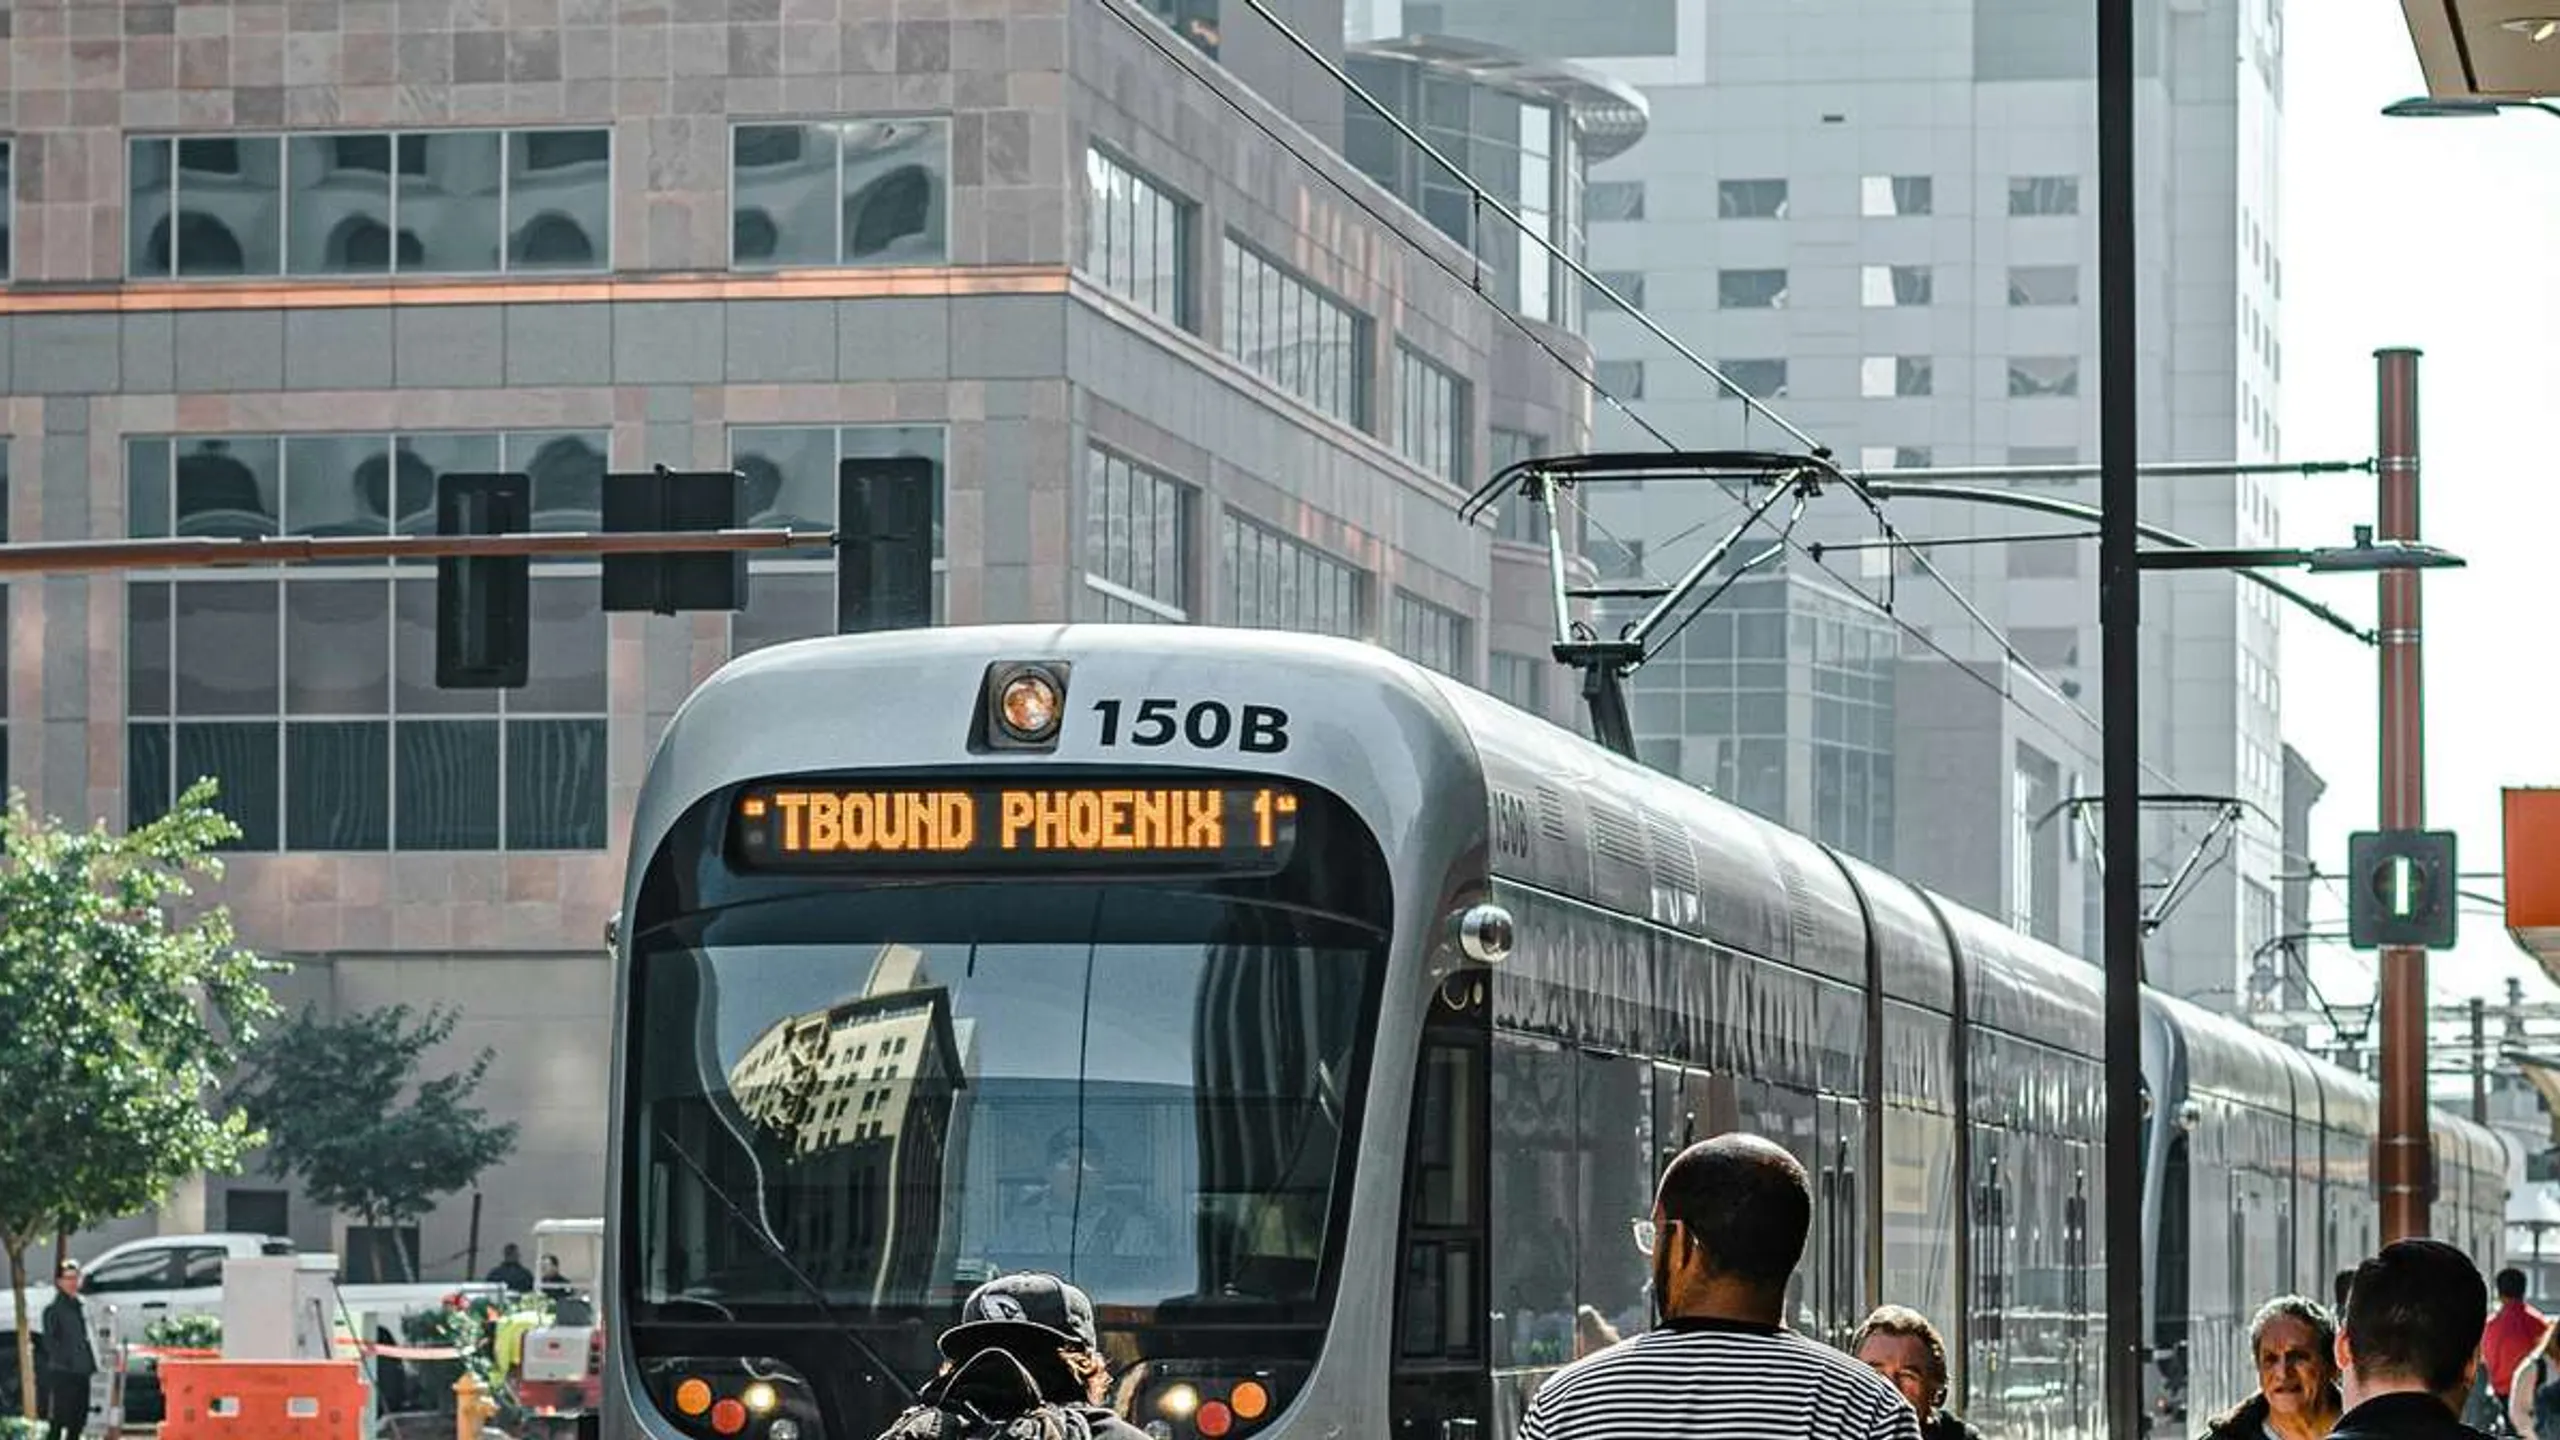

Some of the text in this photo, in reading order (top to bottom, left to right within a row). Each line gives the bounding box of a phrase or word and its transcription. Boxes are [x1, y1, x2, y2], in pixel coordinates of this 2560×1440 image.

[1092, 699, 1289, 754] 150B
[776, 791, 974, 850] TBOUND
[1001, 789, 1222, 848] PHOENIX
